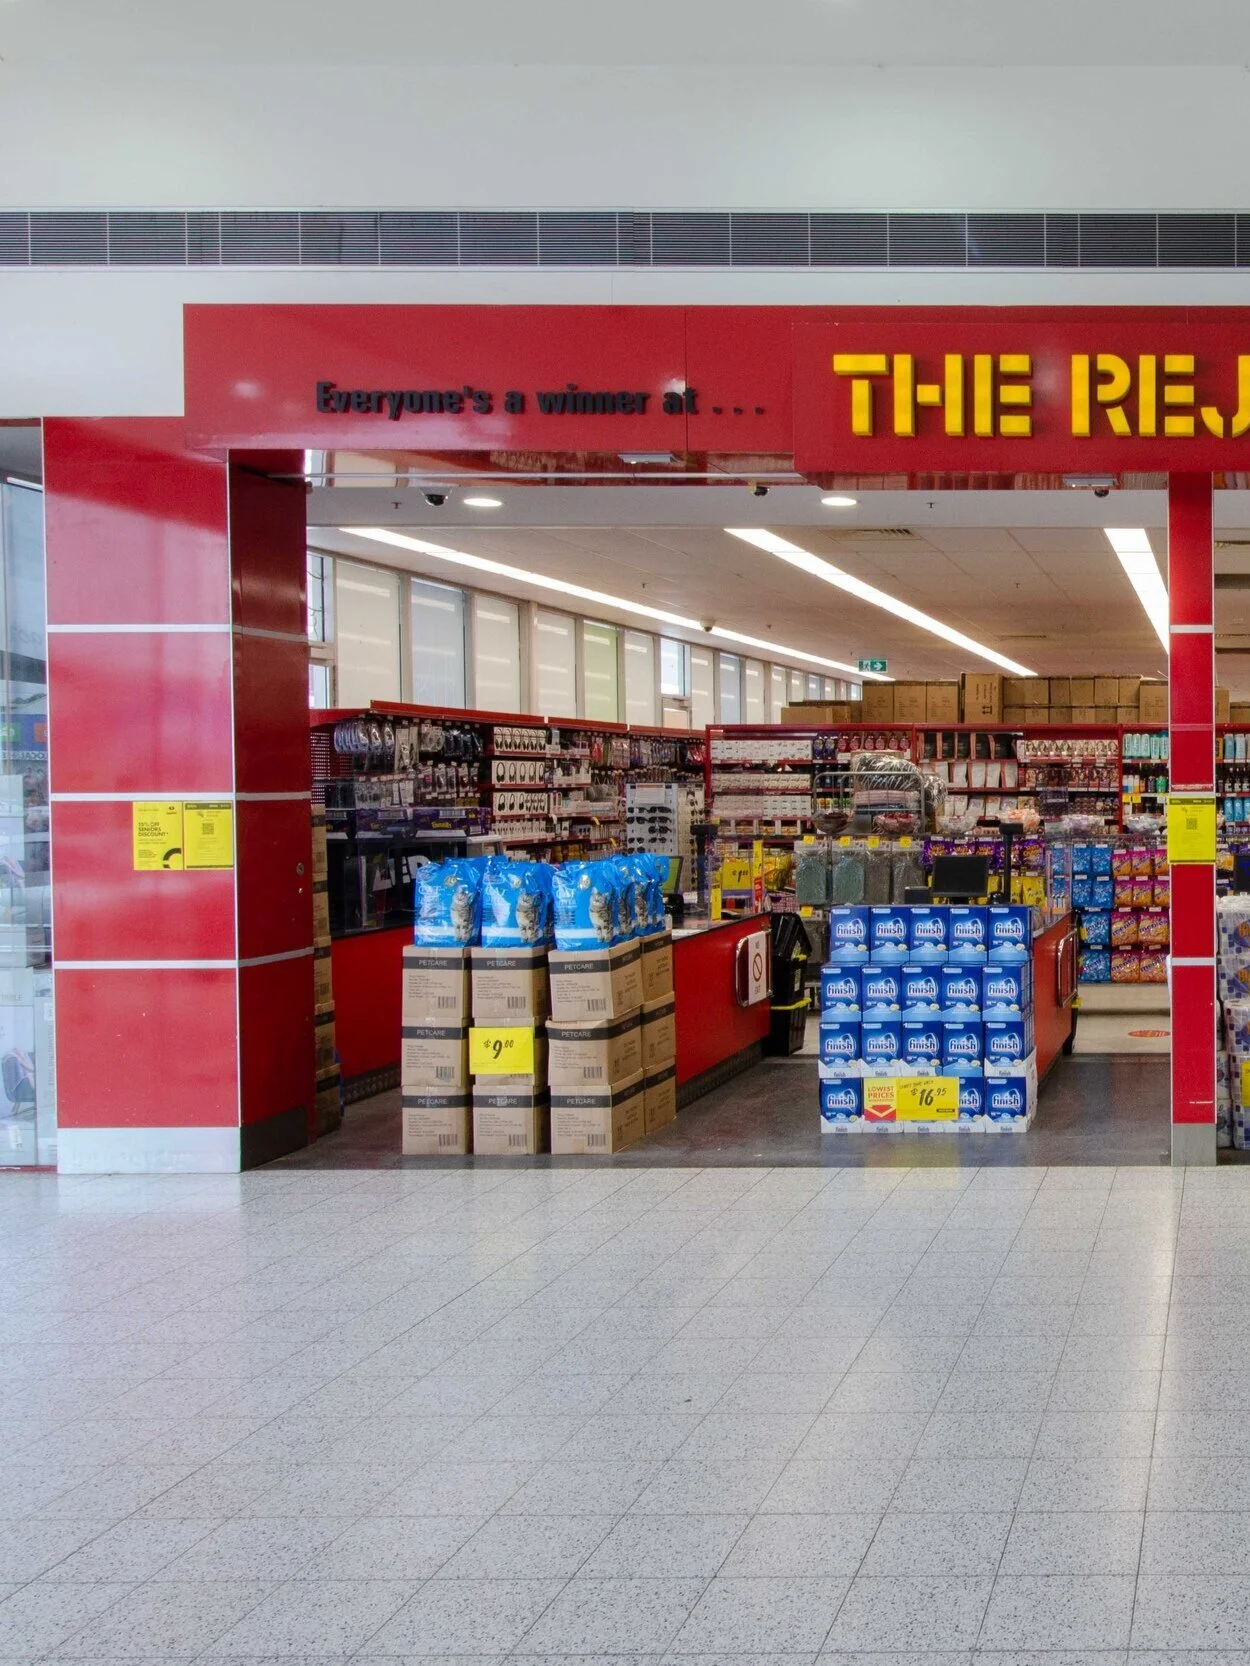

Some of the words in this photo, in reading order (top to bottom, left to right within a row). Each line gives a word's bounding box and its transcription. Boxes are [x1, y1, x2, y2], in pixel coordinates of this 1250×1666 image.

[316, 381, 492, 420] Everyone's
[504, 389, 524, 415] a
[536, 383, 648, 416] winner
[662, 385, 698, 415] at
[832, 353, 1033, 437] THE
[836, 923, 864, 936] finish
[876, 923, 903, 936] finish
[916, 923, 943, 936] finish
[955, 924, 981, 936] finish
[994, 923, 1022, 935] finish
[564, 963, 594, 971] PETCARE
[827, 982, 855, 995] finish
[867, 982, 895, 995] finish
[907, 982, 935, 995] finish
[947, 982, 975, 995] finish
[988, 982, 1015, 995] finish
[561, 1030, 592, 1038] PETCARE
[826, 1038, 853, 1051] finish
[867, 1038, 895, 1051] finish
[908, 1038, 936, 1051] finish
[949, 1038, 977, 1051] finish
[992, 1038, 1019, 1051] finish
[827, 1094, 855, 1106] finish
[992, 1093, 1019, 1106] finish
